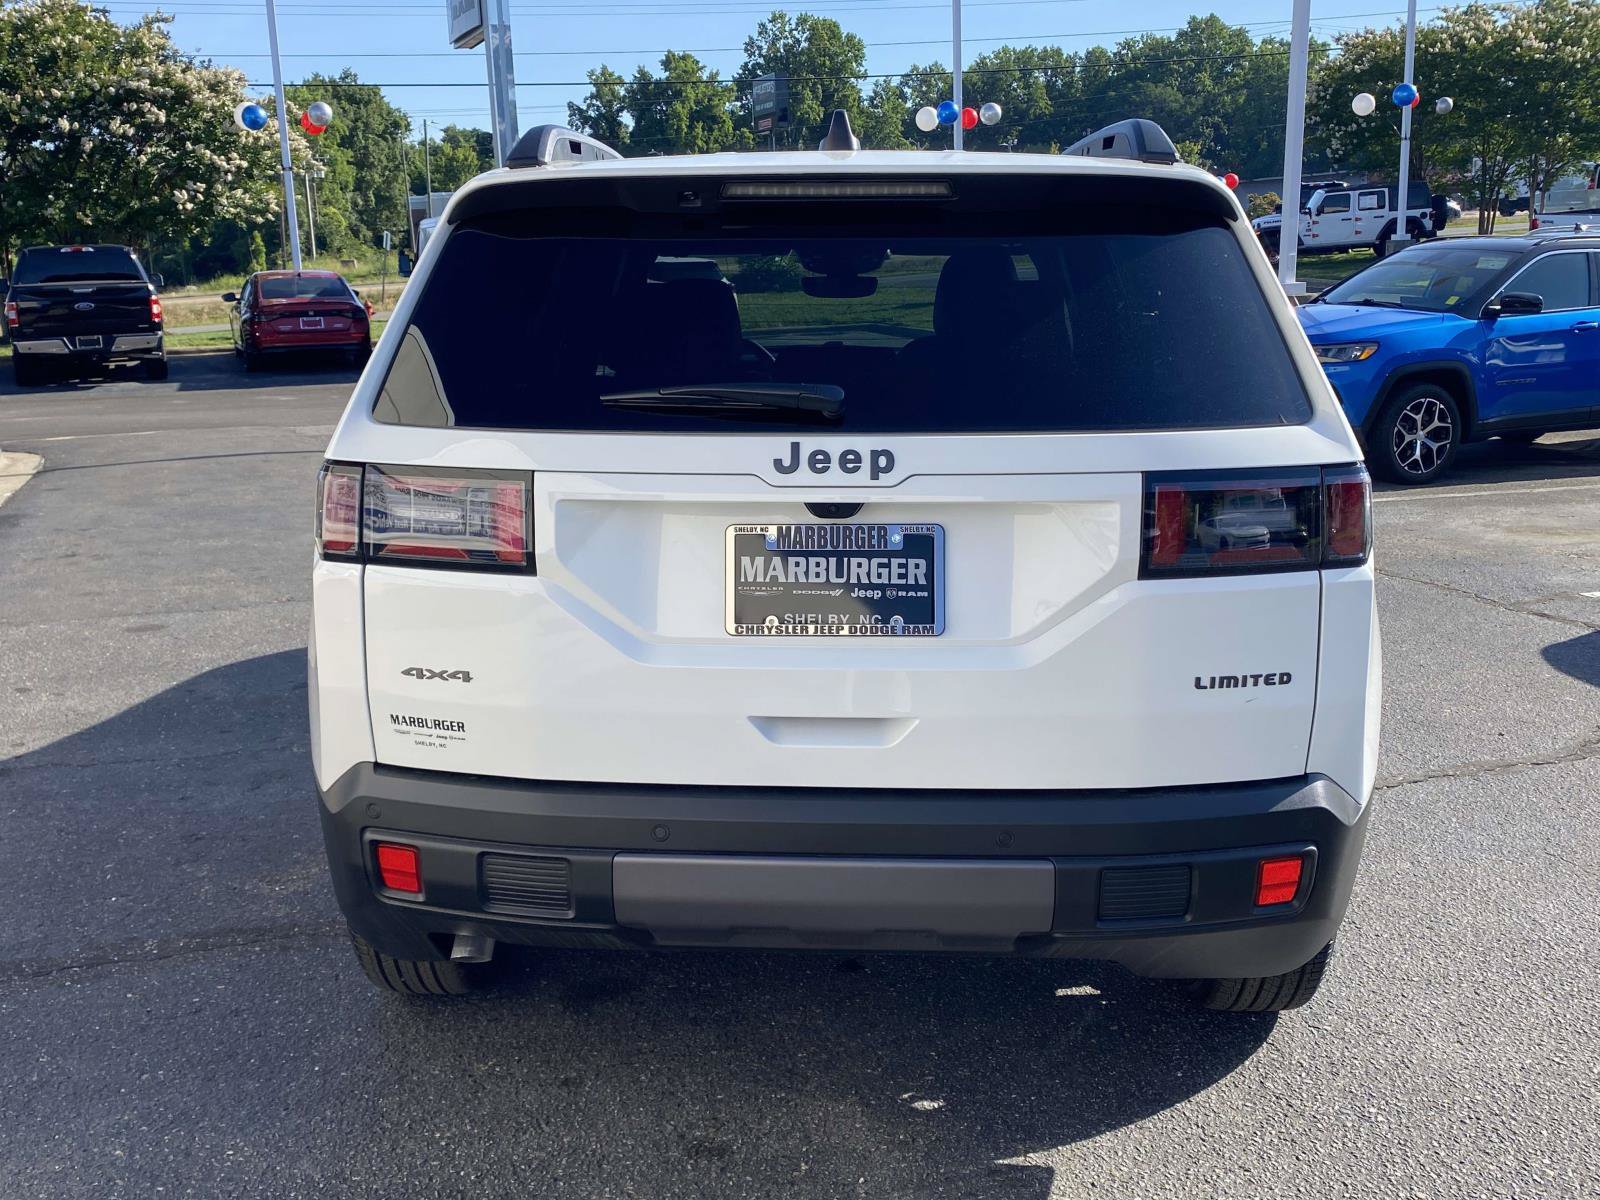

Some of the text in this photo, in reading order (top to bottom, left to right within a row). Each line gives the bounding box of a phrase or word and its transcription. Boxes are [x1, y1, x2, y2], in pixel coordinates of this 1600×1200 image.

[773, 441, 895, 480] Jeep
[777, 526, 888, 550] MARBURGER
[740, 556, 927, 585] MARBURGER
[850, 587, 882, 600] Jeep
[859, 614, 882, 624] NC
[734, 625, 935, 635] CHRYSLER JEEP DODGE RAM
[1194, 671, 1292, 690] LIMITED
[389, 713, 466, 733] MARBURGER
